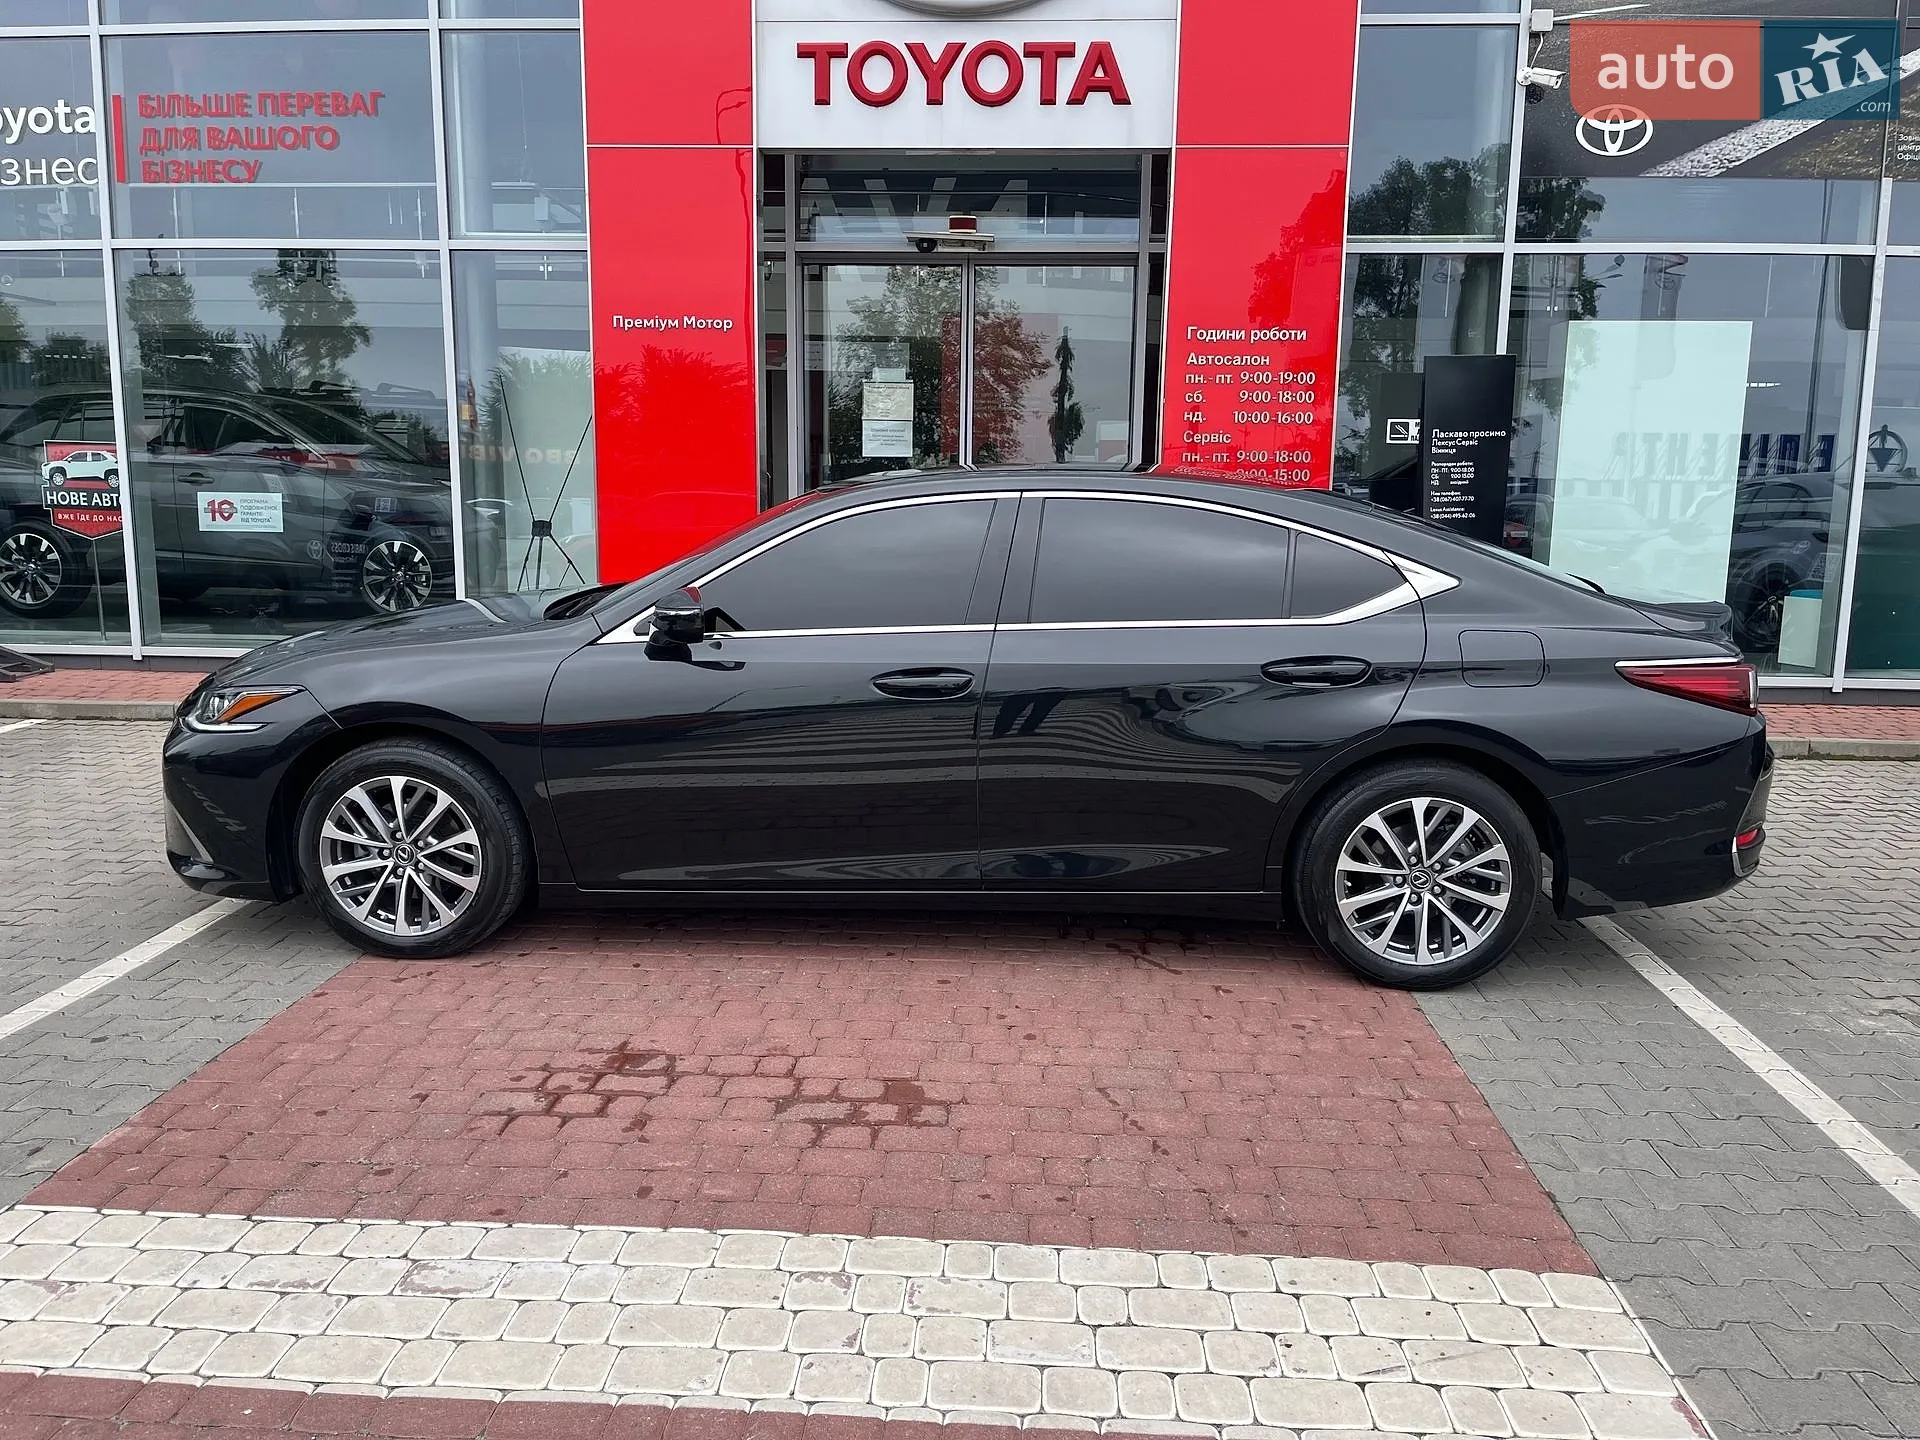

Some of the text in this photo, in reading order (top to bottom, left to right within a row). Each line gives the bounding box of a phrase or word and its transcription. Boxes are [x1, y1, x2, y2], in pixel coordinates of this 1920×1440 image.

[797, 40, 1132, 108] TOYOTA
[138, 90, 385, 119] БІЛЬШЕ ПЕРЕВАГ
[0, 99, 96, 145] yota
[140, 125, 340, 155] ДЛЯ ВАШОГО
[141, 159, 261, 184] БІЗНЕСУ
[612, 315, 733, 332] Преміум Мотор
[1187, 326, 1307, 343] Години роботи
[1186, 352, 1270, 366] Автосалон
[1240, 371, 1316, 384] 9:00-19:00
[1185, 390, 1315, 403] сб. 9:00-18:00
[1183, 411, 1313, 424] нд. 10:00-16:00
[1183, 430, 1232, 446] Сервіс
[1432, 428, 1469, 438] Ласкаво
[1469, 430, 1507, 439] просимо
[1237, 450, 1311, 463] 9:00-18:00
[46, 490, 121, 507] НОВЕ АВТ
[77, 513, 90, 521] ЇДЕ
